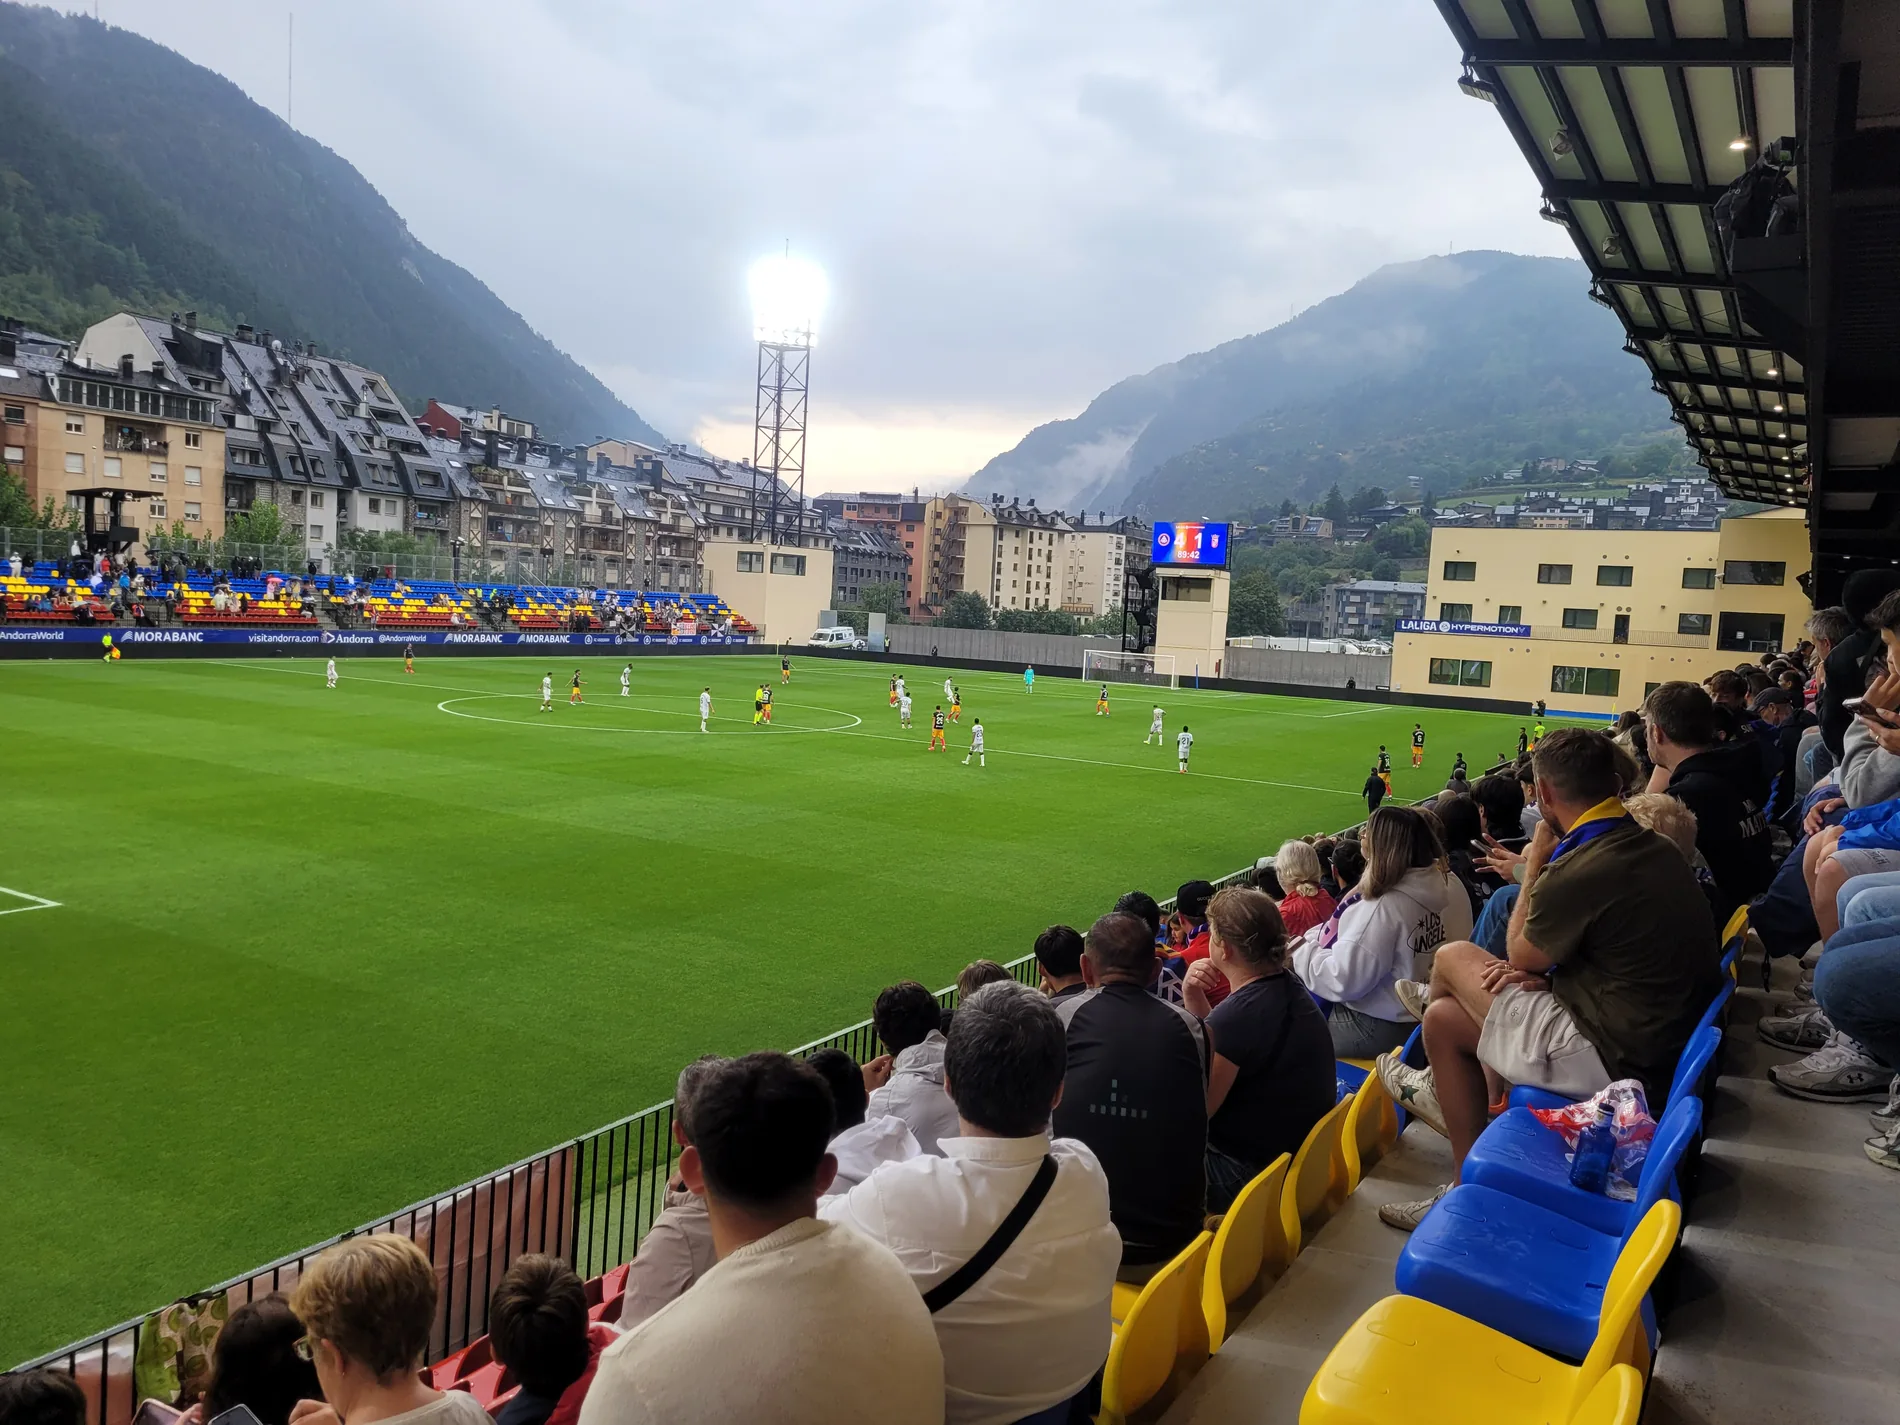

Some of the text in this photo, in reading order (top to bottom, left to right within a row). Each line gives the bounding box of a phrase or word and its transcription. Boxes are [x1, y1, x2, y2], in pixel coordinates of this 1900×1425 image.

[1194, 532, 1202, 549] 1
[1401, 620, 1437, 631] LALIGA
[0, 631, 64, 640] AndorraWorld
[134, 631, 204, 642] MORABANC
[249, 633, 319, 643] visitandorra.com
[335, 633, 374, 644] Andorra
[378, 633, 427, 643] @AndorraWorld
[453, 633, 503, 643] MORABANC
[526, 634, 571, 643] MORABANC
[1181, 737, 1189, 745] 21
